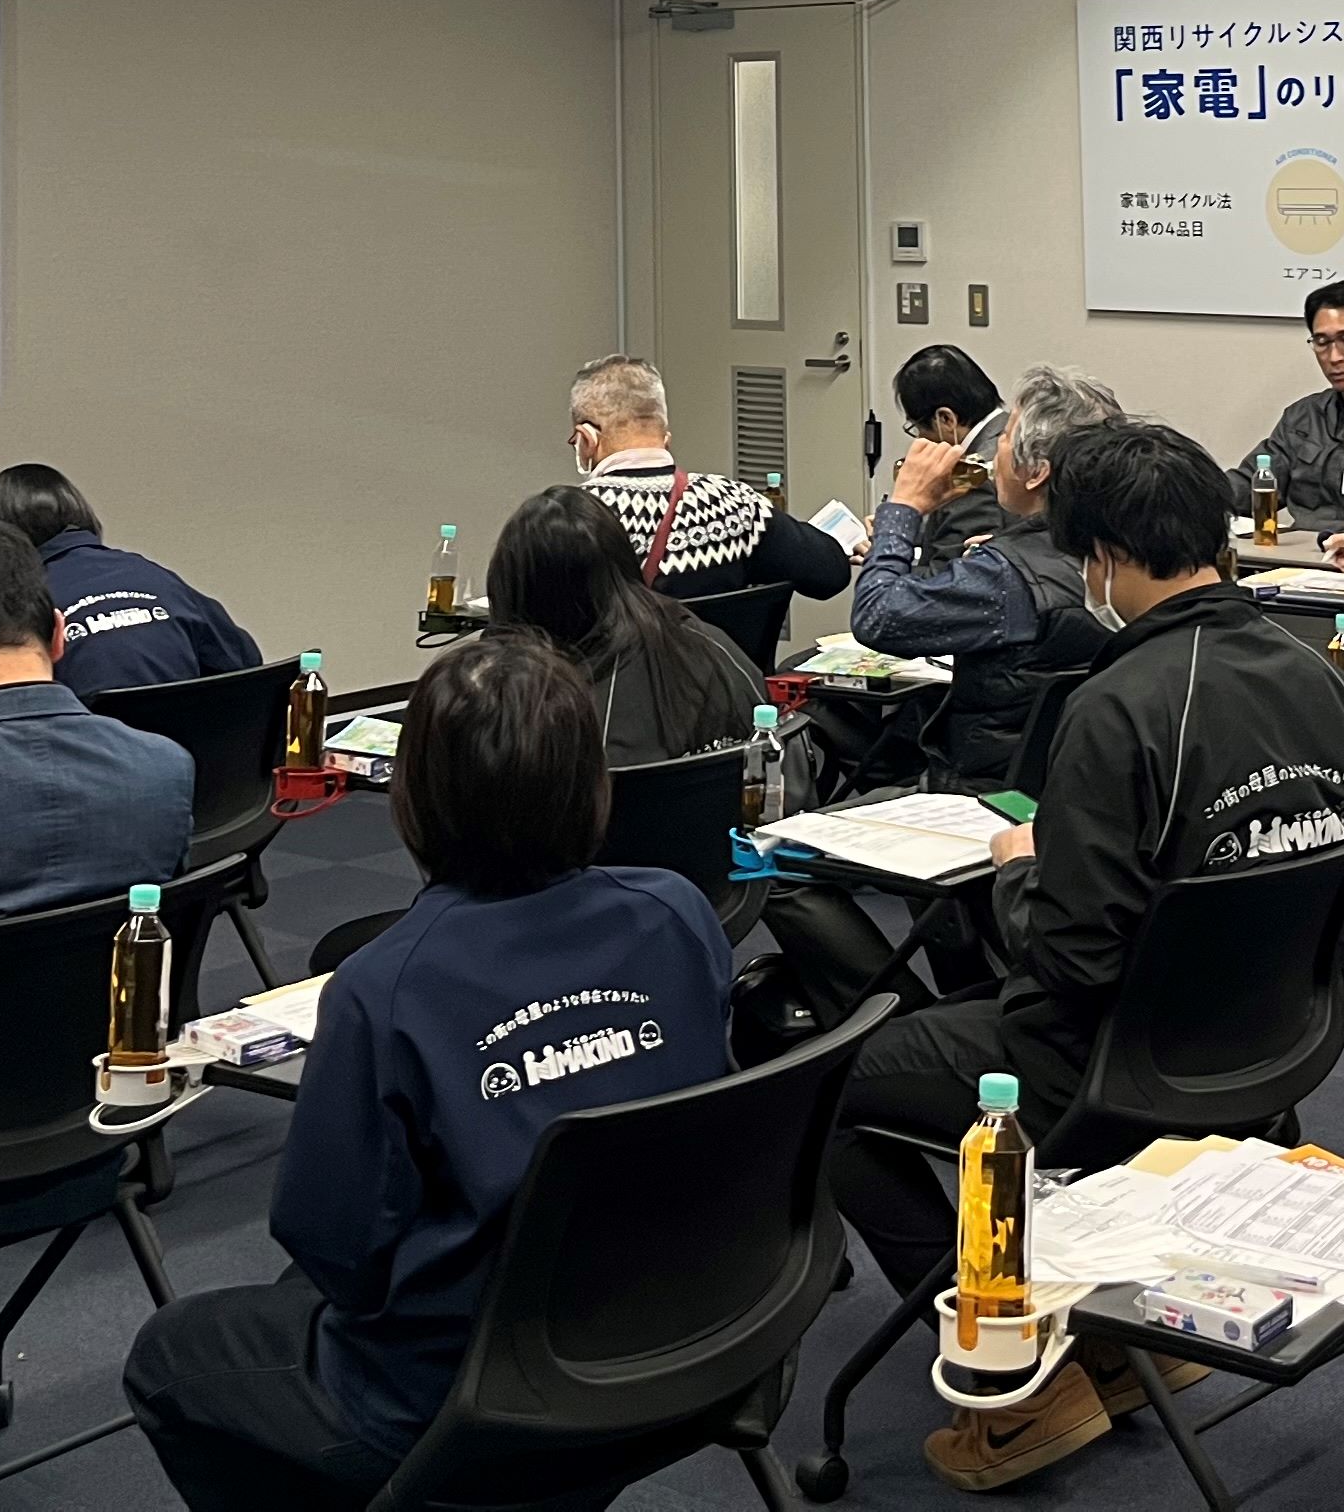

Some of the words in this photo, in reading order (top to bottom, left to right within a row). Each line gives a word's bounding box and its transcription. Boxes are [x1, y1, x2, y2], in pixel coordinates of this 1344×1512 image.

[1120, 192, 1233, 210] 家電リサイクル法
[1120, 220, 1204, 238] 対象の4品目
[1282, 268, 1338, 281] エアコン
